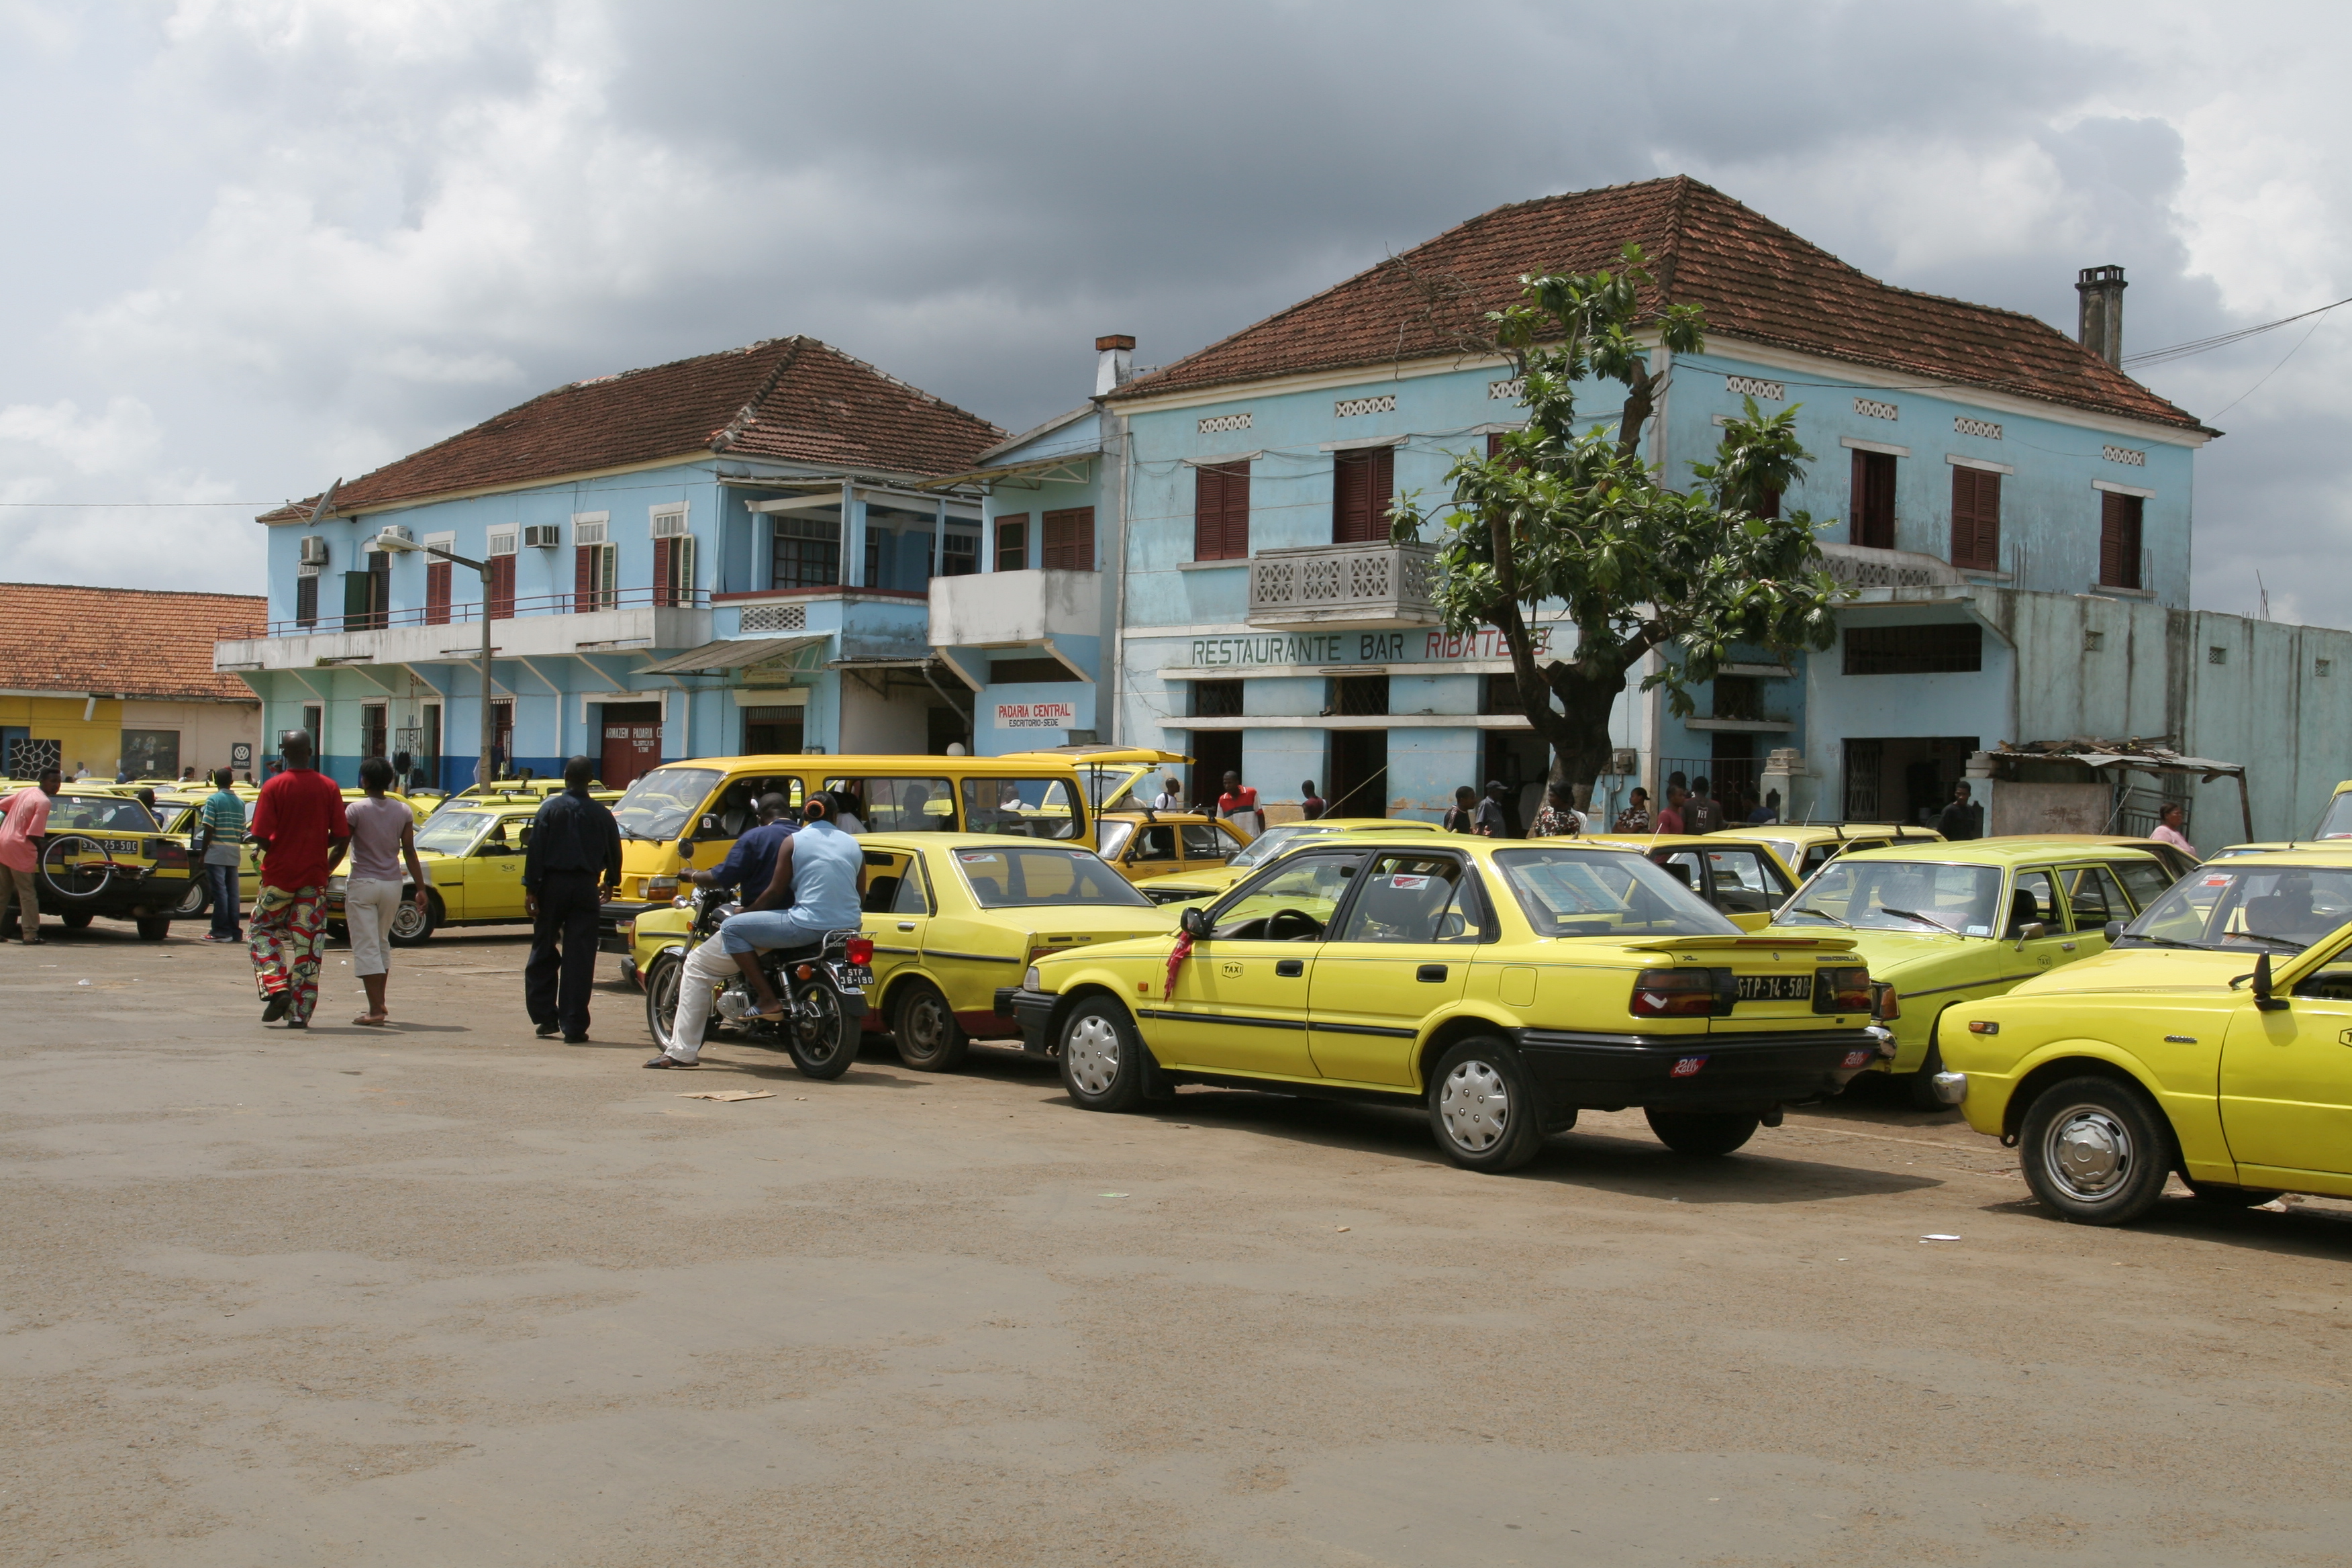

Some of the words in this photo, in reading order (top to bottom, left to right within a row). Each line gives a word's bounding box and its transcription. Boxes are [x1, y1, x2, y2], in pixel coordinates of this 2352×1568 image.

[1192, 635, 1342, 665] RESTAURANTE
[1360, 633, 1404, 660] BAR
[1425, 629, 1548, 658] RIBATEO
[999, 705, 1029, 718] PADARIA
[1034, 703, 1071, 717] CENTRAL
[605, 727, 629, 738] ARMAZEM
[633, 727, 653, 738] PADARIA
[1224, 965, 1242, 973] TAXI
[1845, 1051, 1864, 1065] Rally
[1675, 1059, 1699, 1075] Rally
